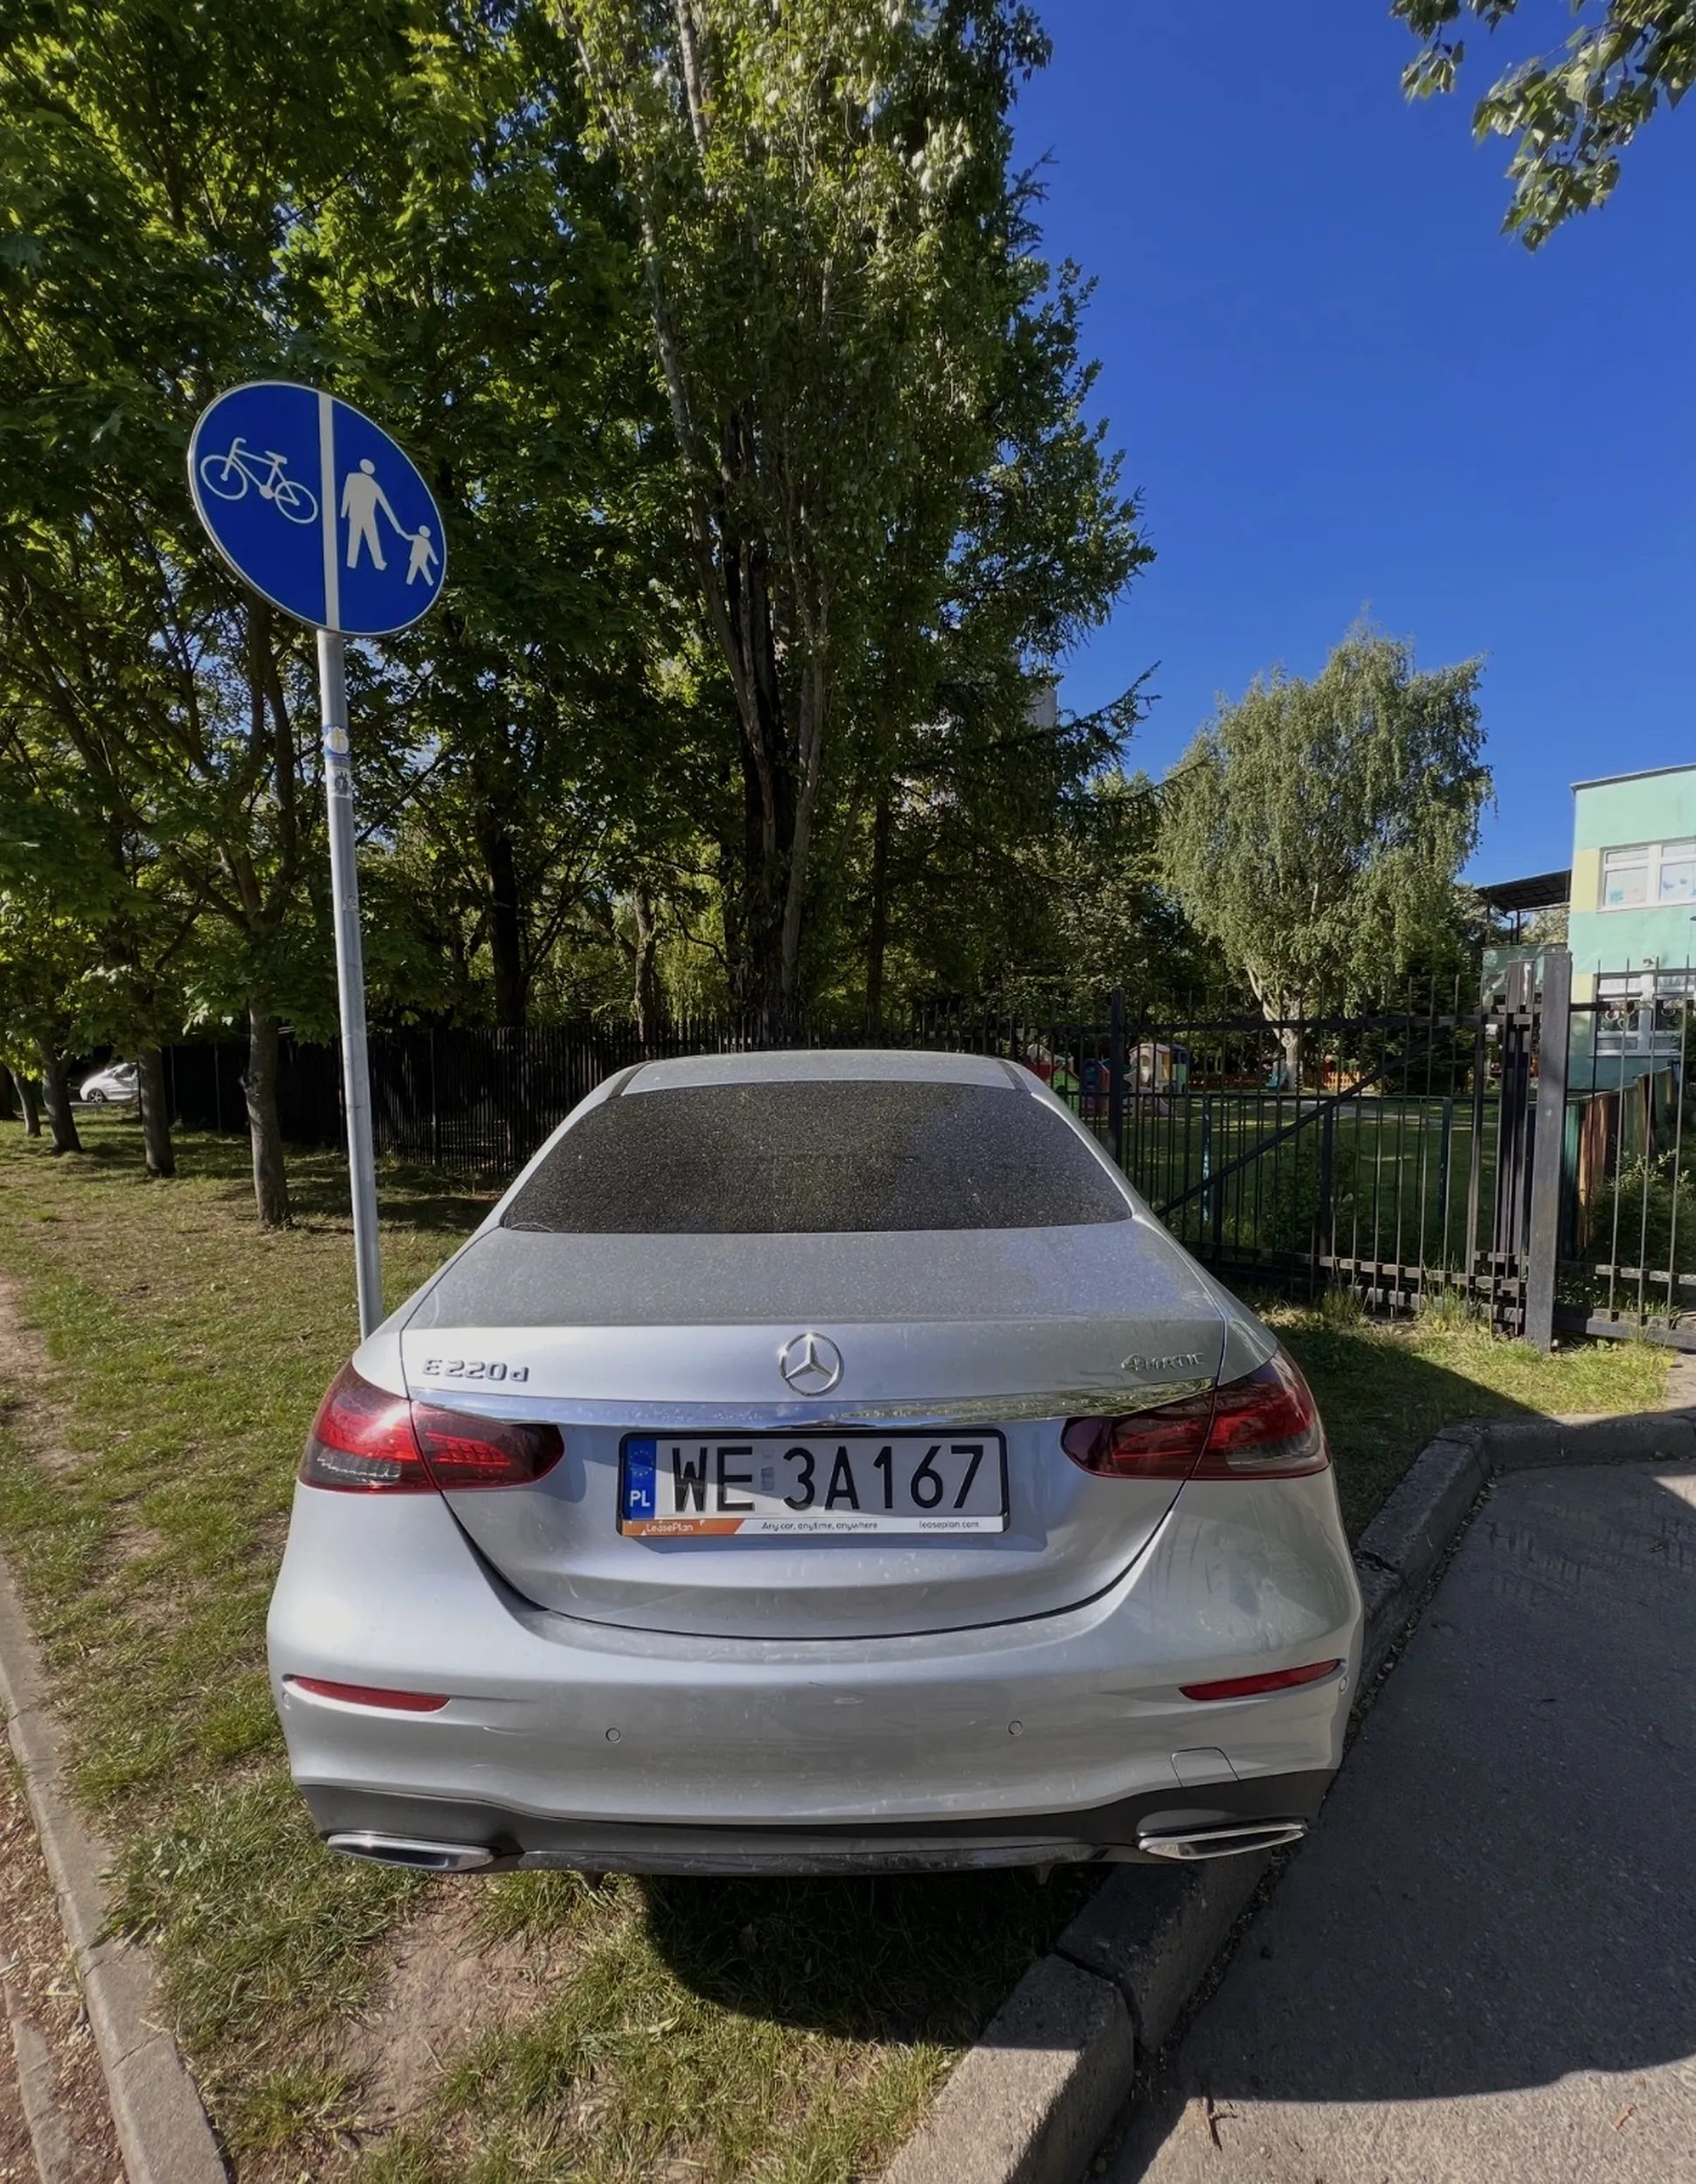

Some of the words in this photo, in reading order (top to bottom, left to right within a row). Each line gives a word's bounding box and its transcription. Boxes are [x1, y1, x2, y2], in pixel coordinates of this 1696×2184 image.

[672, 1446, 755, 1512] WE
[782, 1444, 986, 1512] 3A167
[629, 1489, 651, 1508] PL
[647, 1523, 694, 1533] LeasePlan
[761, 1521, 779, 1531] Any
[797, 1522, 834, 1531] anytime,
[836, 1522, 879, 1531] anywhere
[918, 1520, 980, 1530] leaseplan.com
